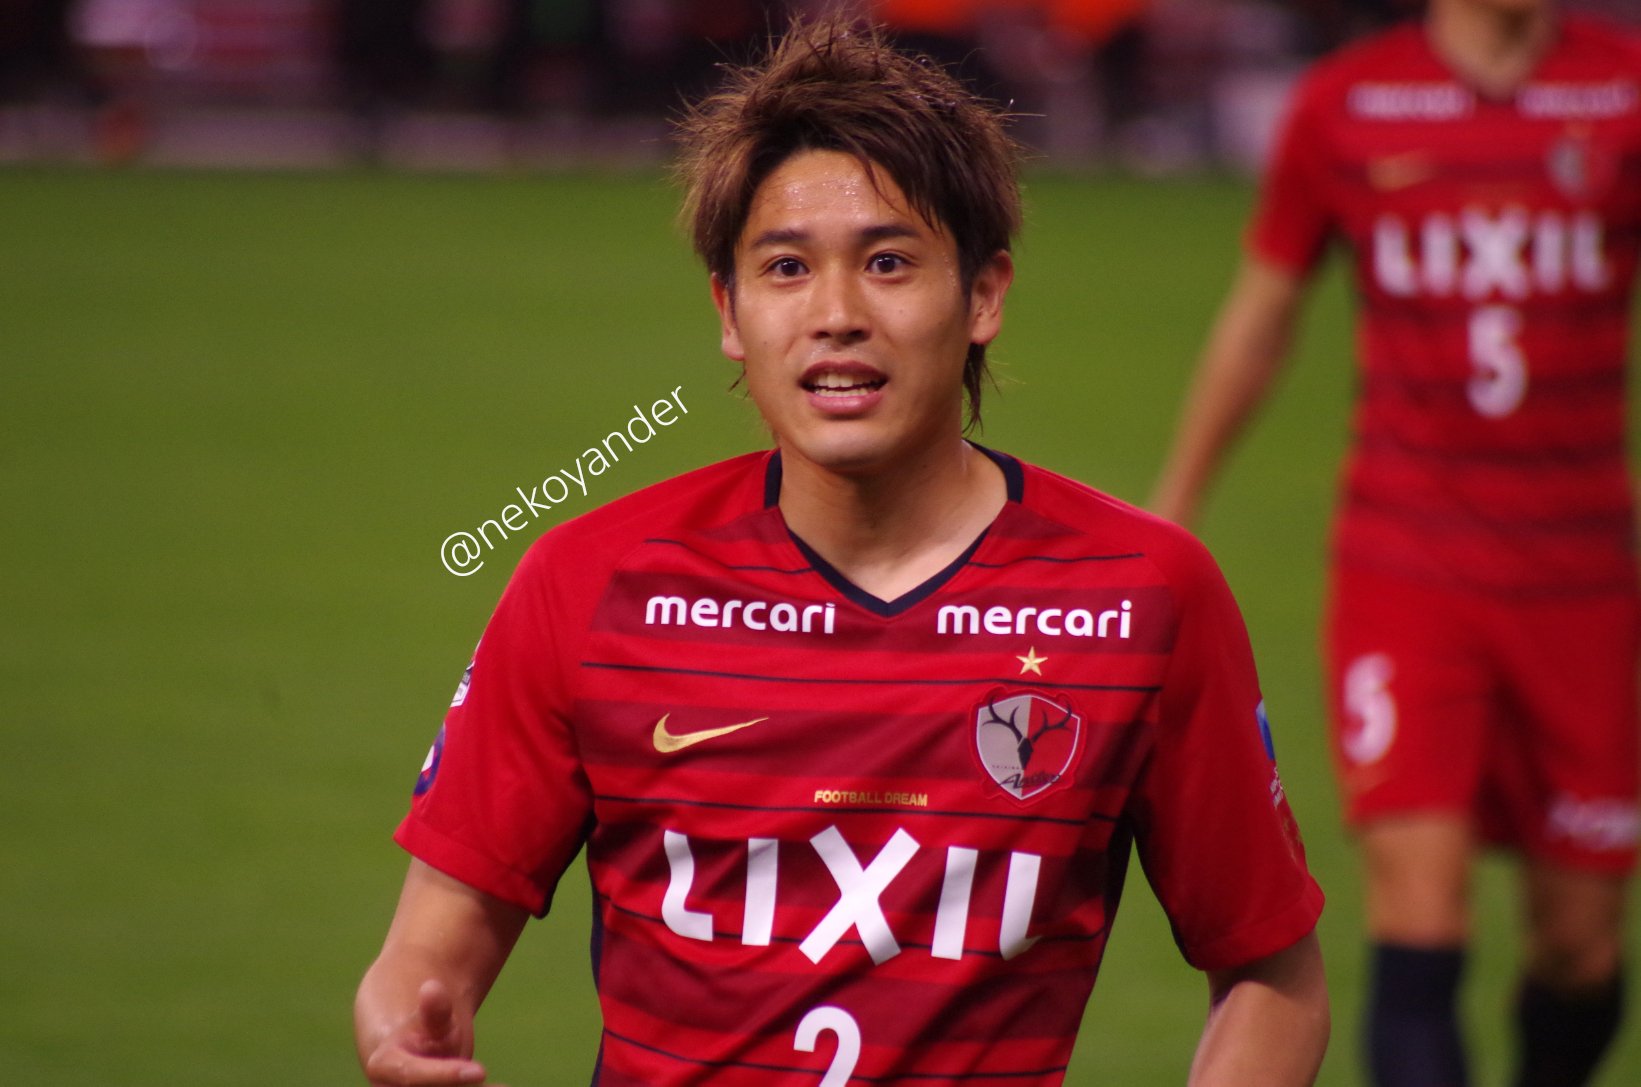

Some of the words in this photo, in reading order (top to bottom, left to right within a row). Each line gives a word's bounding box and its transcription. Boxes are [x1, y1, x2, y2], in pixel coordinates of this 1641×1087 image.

[1374, 206, 1609, 299] LIXIL
[1467, 303, 1527, 418] 5
[645, 596, 836, 634] mercari
[937, 600, 1132, 639] mercari
[1342, 653, 1396, 765] 5
[814, 790, 882, 804] FOOTBALL
[884, 792, 928, 807] DREAM
[662, 824, 1043, 966] LIXIL
[793, 1006, 861, 1087] 2
